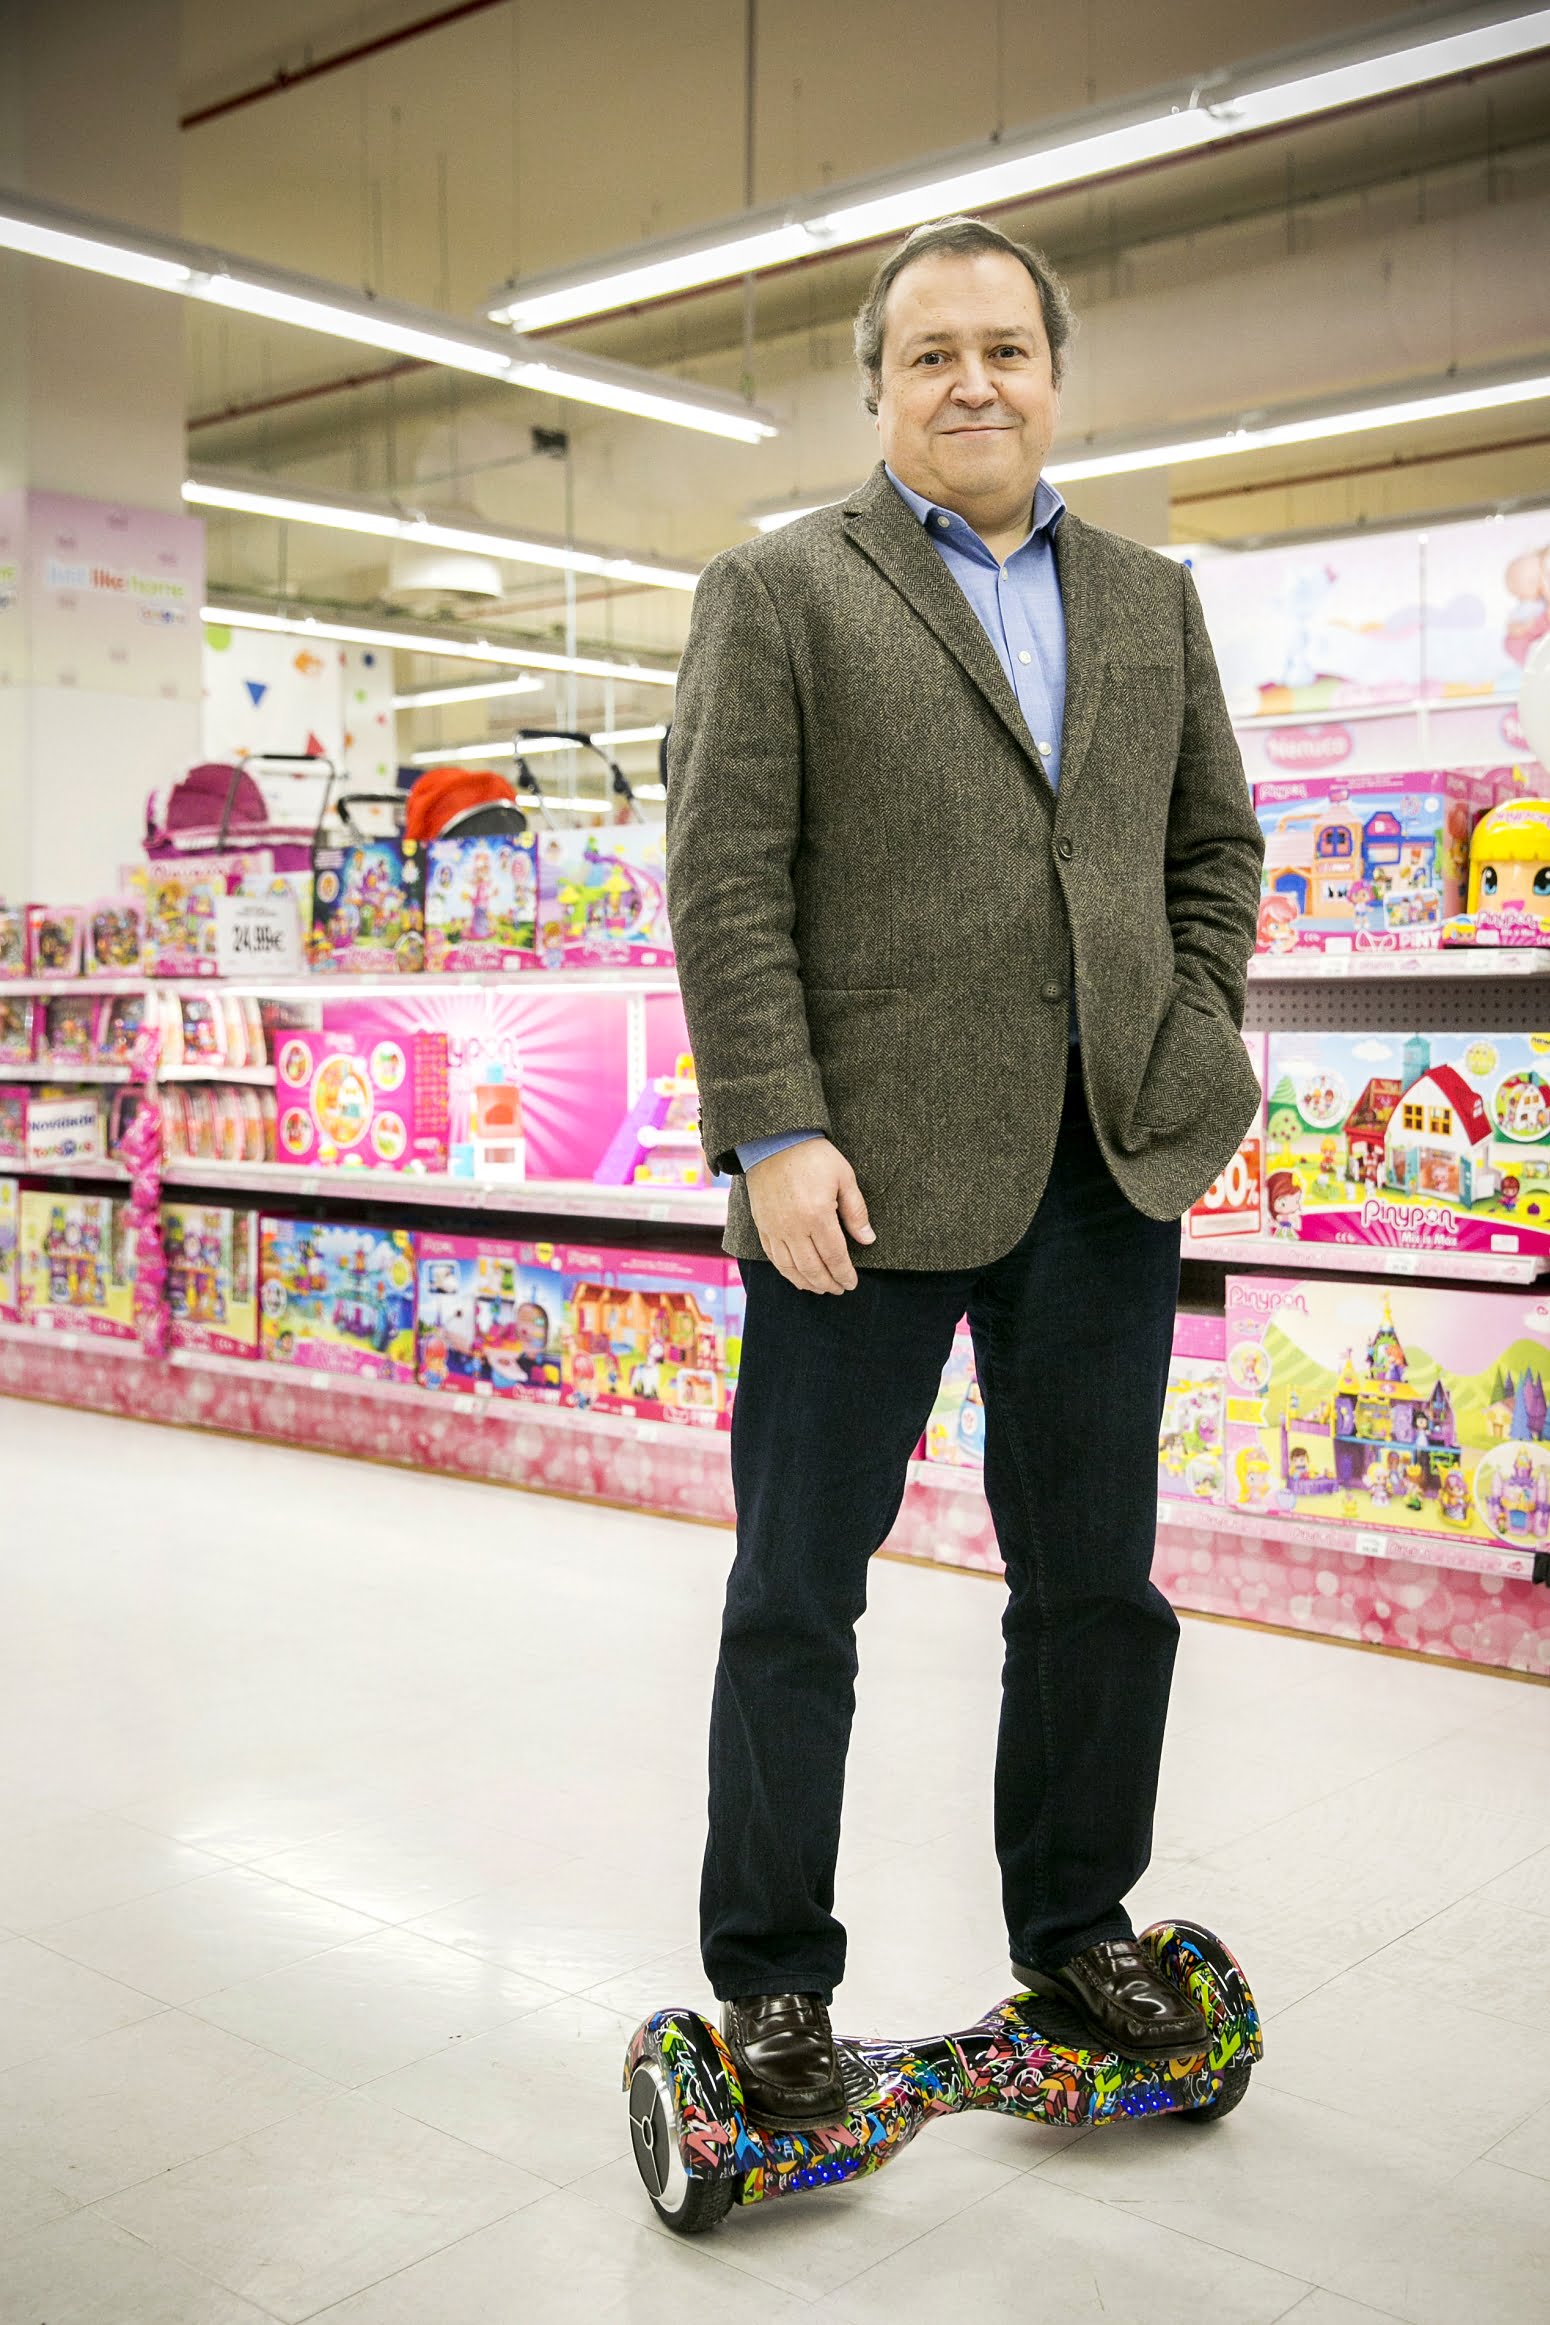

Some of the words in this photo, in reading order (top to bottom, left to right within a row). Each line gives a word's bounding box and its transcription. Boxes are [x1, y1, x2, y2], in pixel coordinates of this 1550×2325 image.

[1361, 1199, 1459, 1234] Pinypon
[1401, 1231, 1420, 1244] Mix
[1434, 1233, 1458, 1247] Max
[1229, 1284, 1309, 1315] Pinypon
